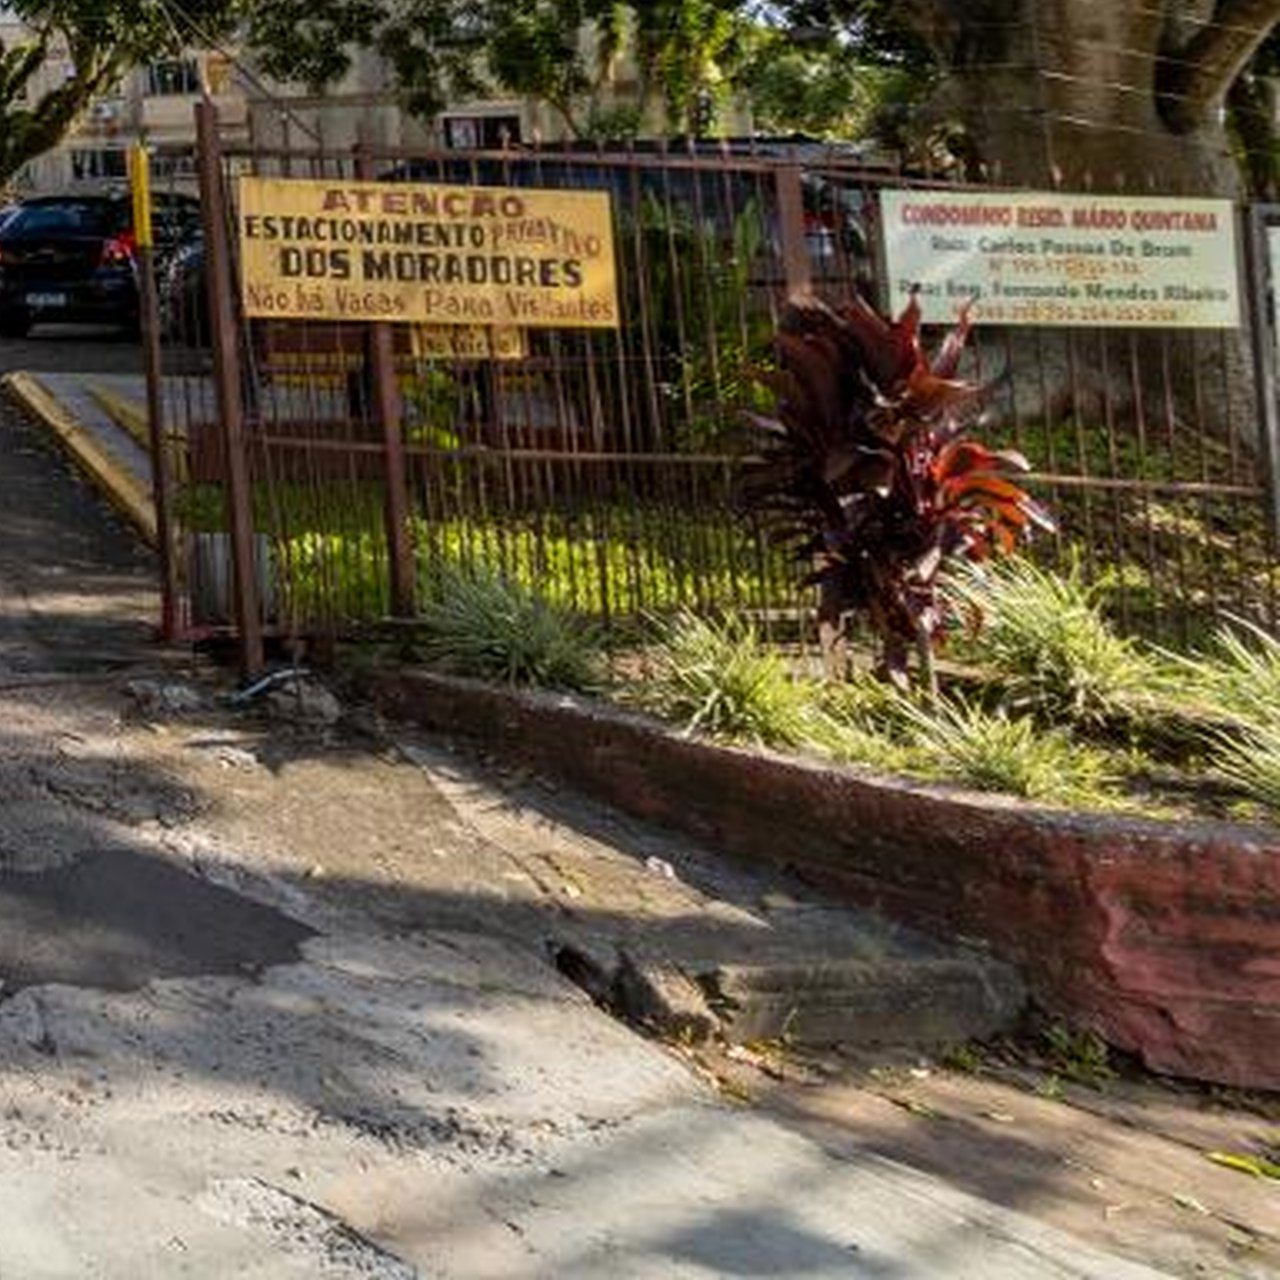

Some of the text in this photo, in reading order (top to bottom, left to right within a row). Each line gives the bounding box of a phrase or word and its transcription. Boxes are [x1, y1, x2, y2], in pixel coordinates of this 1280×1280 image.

[244, 216, 485, 248] ESTACIONAMENTO
[280, 246, 583, 288] DOS MORADORES
[899, 280, 941, 296] Ra:
